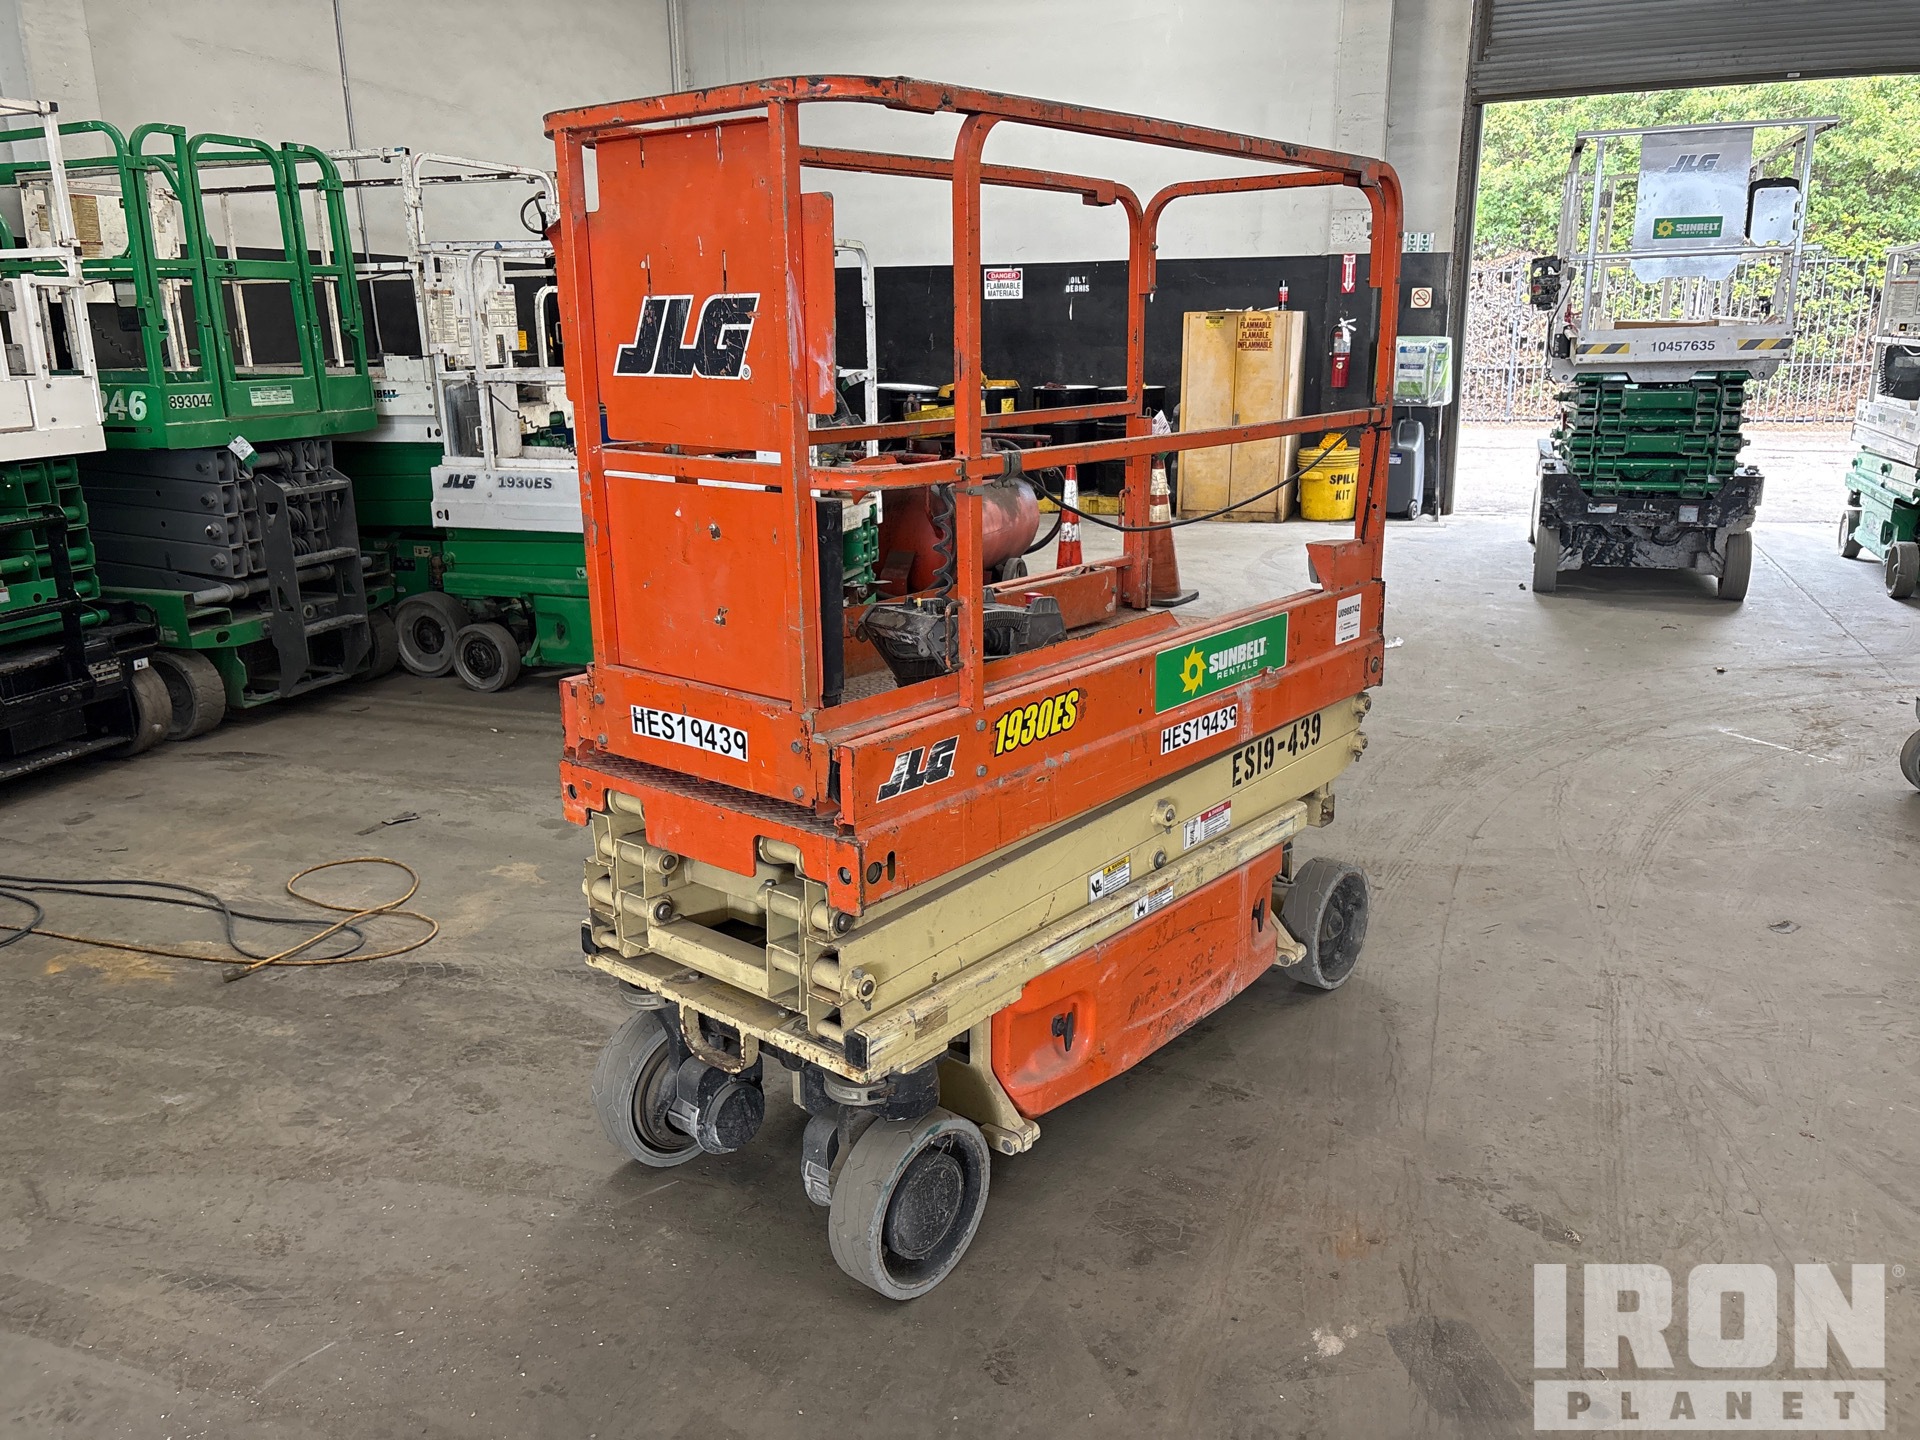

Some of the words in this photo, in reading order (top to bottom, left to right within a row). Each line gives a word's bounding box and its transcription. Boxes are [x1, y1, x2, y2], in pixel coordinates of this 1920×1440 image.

[1666, 153, 1720, 173] JLG
[1676, 222, 1720, 231] SUNBELT
[1070, 276, 1086, 284] OILY
[1065, 285, 1090, 293] DEBRIS
[1240, 321, 1272, 329] FLAMMABLE
[613, 293, 760, 380] JLG
[1241, 331, 1269, 339] FLAMABLE
[1651, 340, 1716, 352] 10457635
[169, 394, 214, 409] 893044
[442, 474, 476, 489] JLG
[498, 476, 553, 489] 1930ES
[1329, 473, 1355, 485] SPILL
[1335, 490, 1350, 500] KIT
[1209, 637, 1267, 674] SUNBELT
[1217, 659, 1258, 680] RENTALS
[994, 688, 1080, 757] 1930ES
[1162, 705, 1237, 754] HES19439
[633, 706, 747, 760] HES19439
[876, 735, 960, 803] JLG
